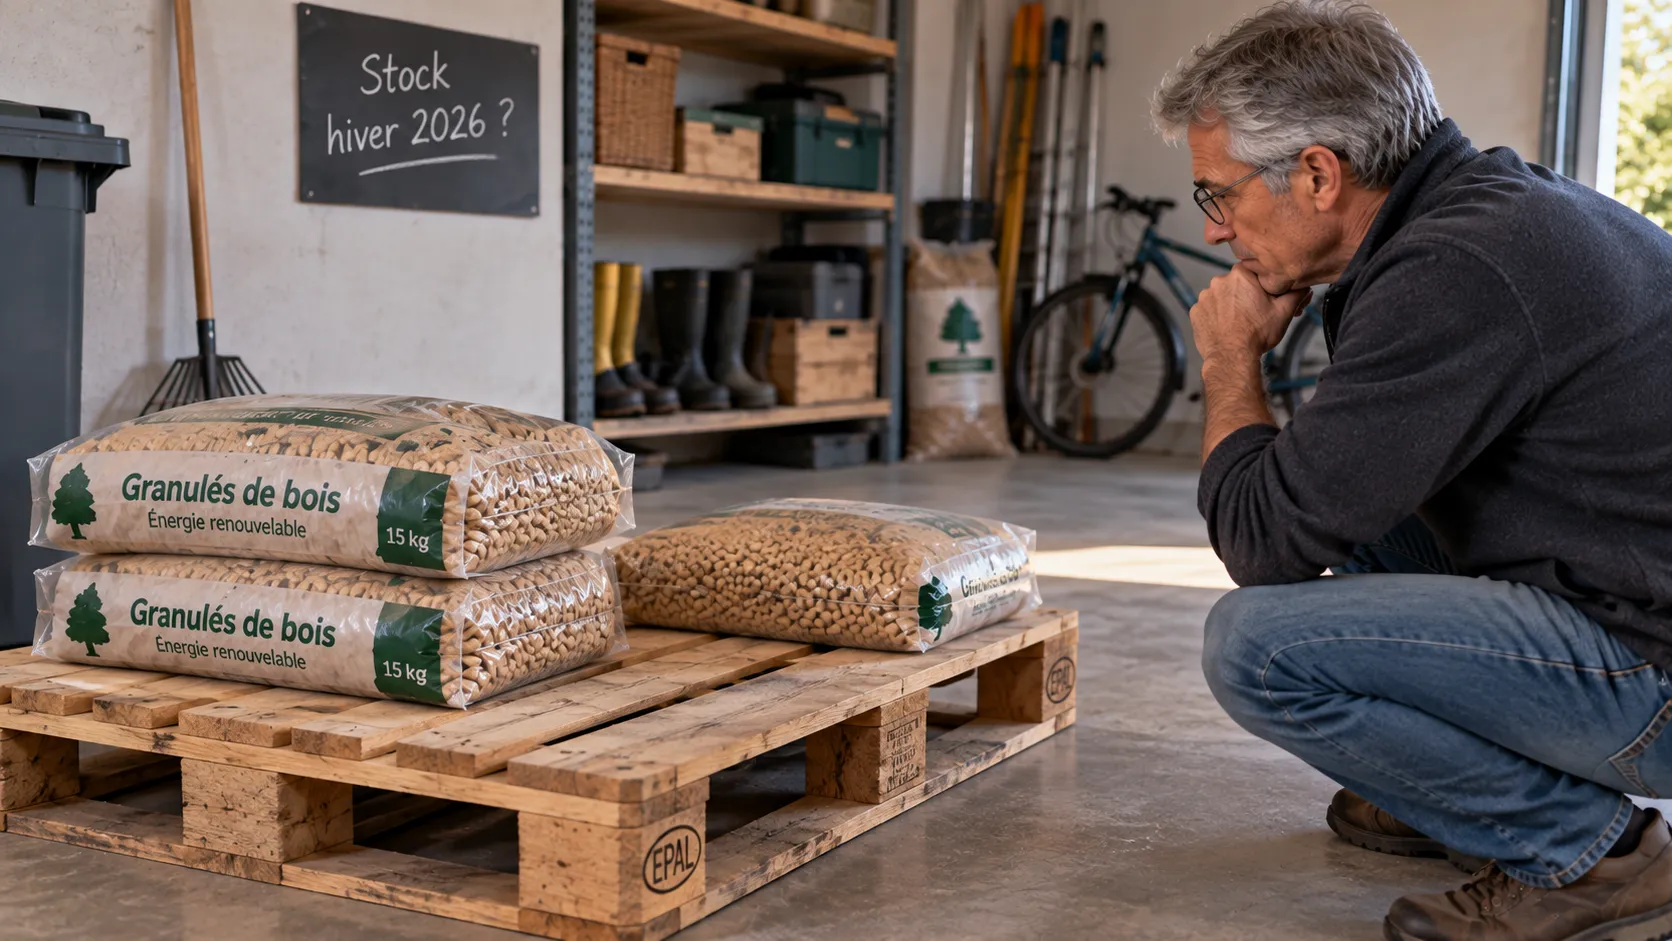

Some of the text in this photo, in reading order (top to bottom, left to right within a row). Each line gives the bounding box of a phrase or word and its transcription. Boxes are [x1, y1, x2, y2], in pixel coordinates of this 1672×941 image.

[360, 50, 451, 95] Stock
[327, 97, 515, 155] hiver 2026 ?
[122, 472, 341, 514] Granulés de bois
[148, 508, 307, 539] Énergie renouvelable
[386, 526, 430, 553] 15 kg
[130, 597, 336, 648] Granulés de bois
[155, 634, 307, 670] Énergie renouvelable
[383, 660, 427, 686] 15 kg
[653, 834, 695, 885] EPAL
